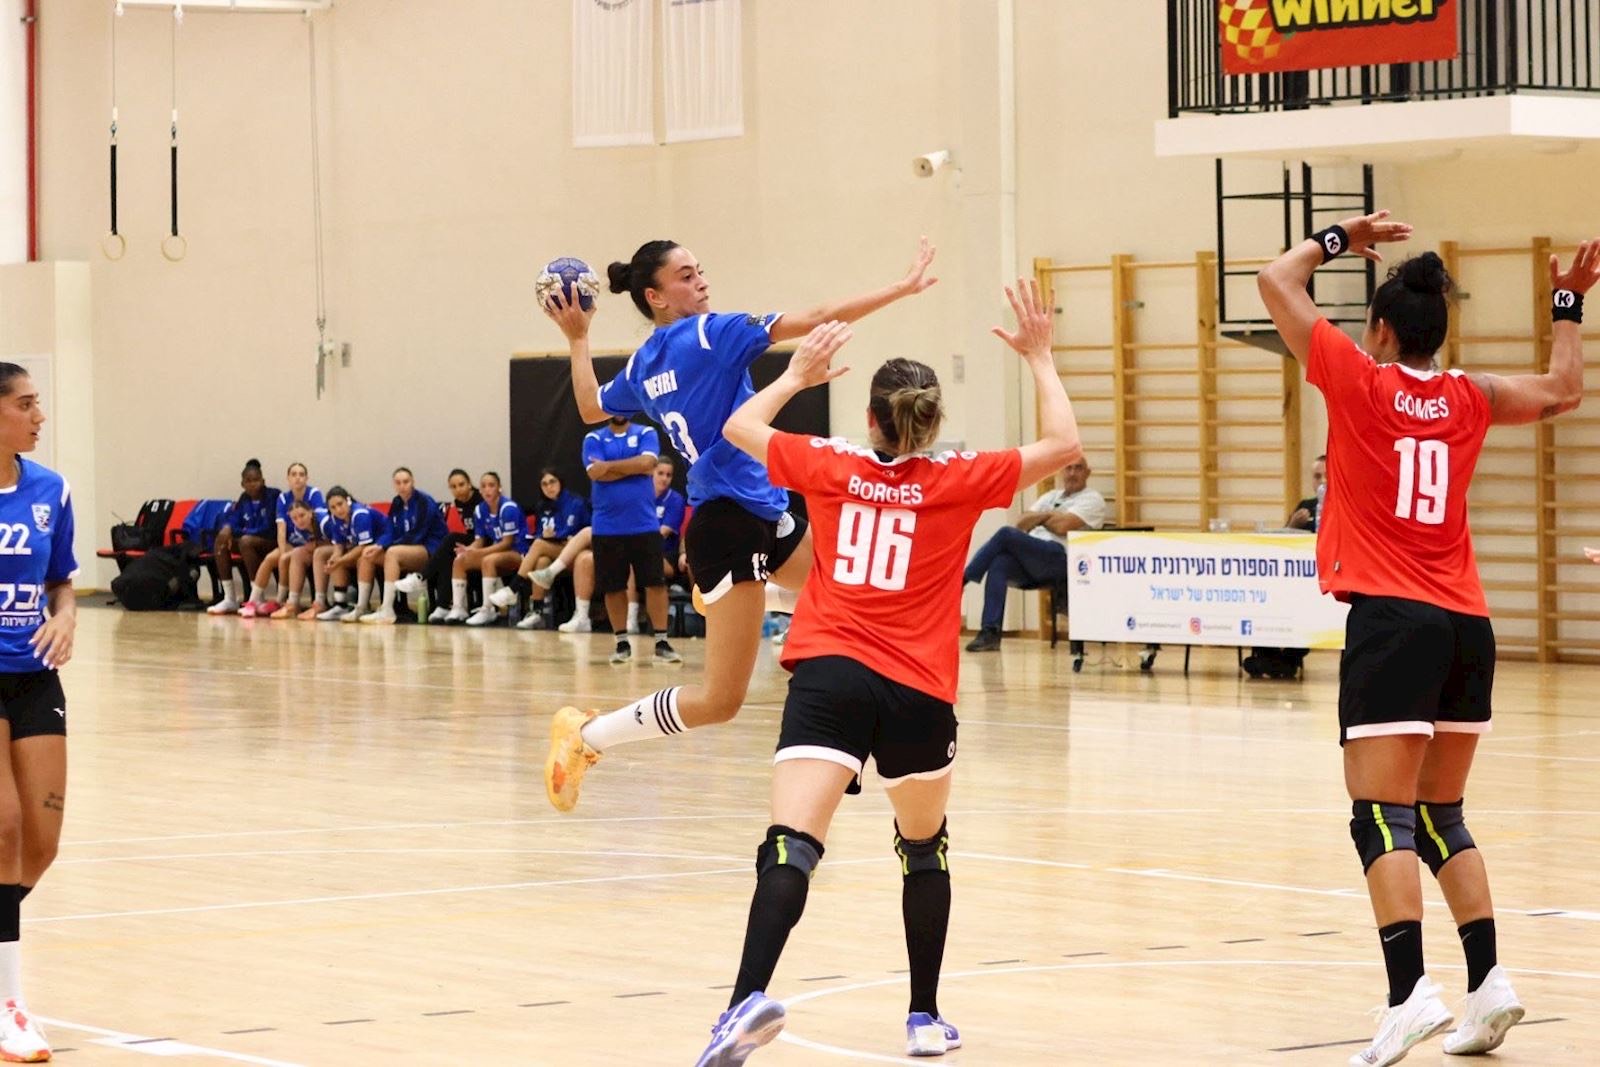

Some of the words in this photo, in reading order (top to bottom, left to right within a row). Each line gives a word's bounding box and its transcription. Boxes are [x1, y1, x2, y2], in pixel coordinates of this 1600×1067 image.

[1394, 390, 1449, 419] GOMES
[660, 411, 700, 465] 3
[848, 474, 923, 505] BORGES
[1394, 436, 1449, 525] 19
[0, 522, 32, 555] 22
[832, 502, 917, 591] 96
[1098, 555, 1147, 574] אשדוד
[1151, 556, 1216, 576] העירונית
[1221, 557, 1279, 577] הספורט
[1284, 559, 1316, 578] שות
[1150, 584, 1184, 600] ישראל
[1187, 586, 1203, 601] של
[1206, 588, 1246, 603] הספורט
[1249, 589, 1267, 603] עיר
